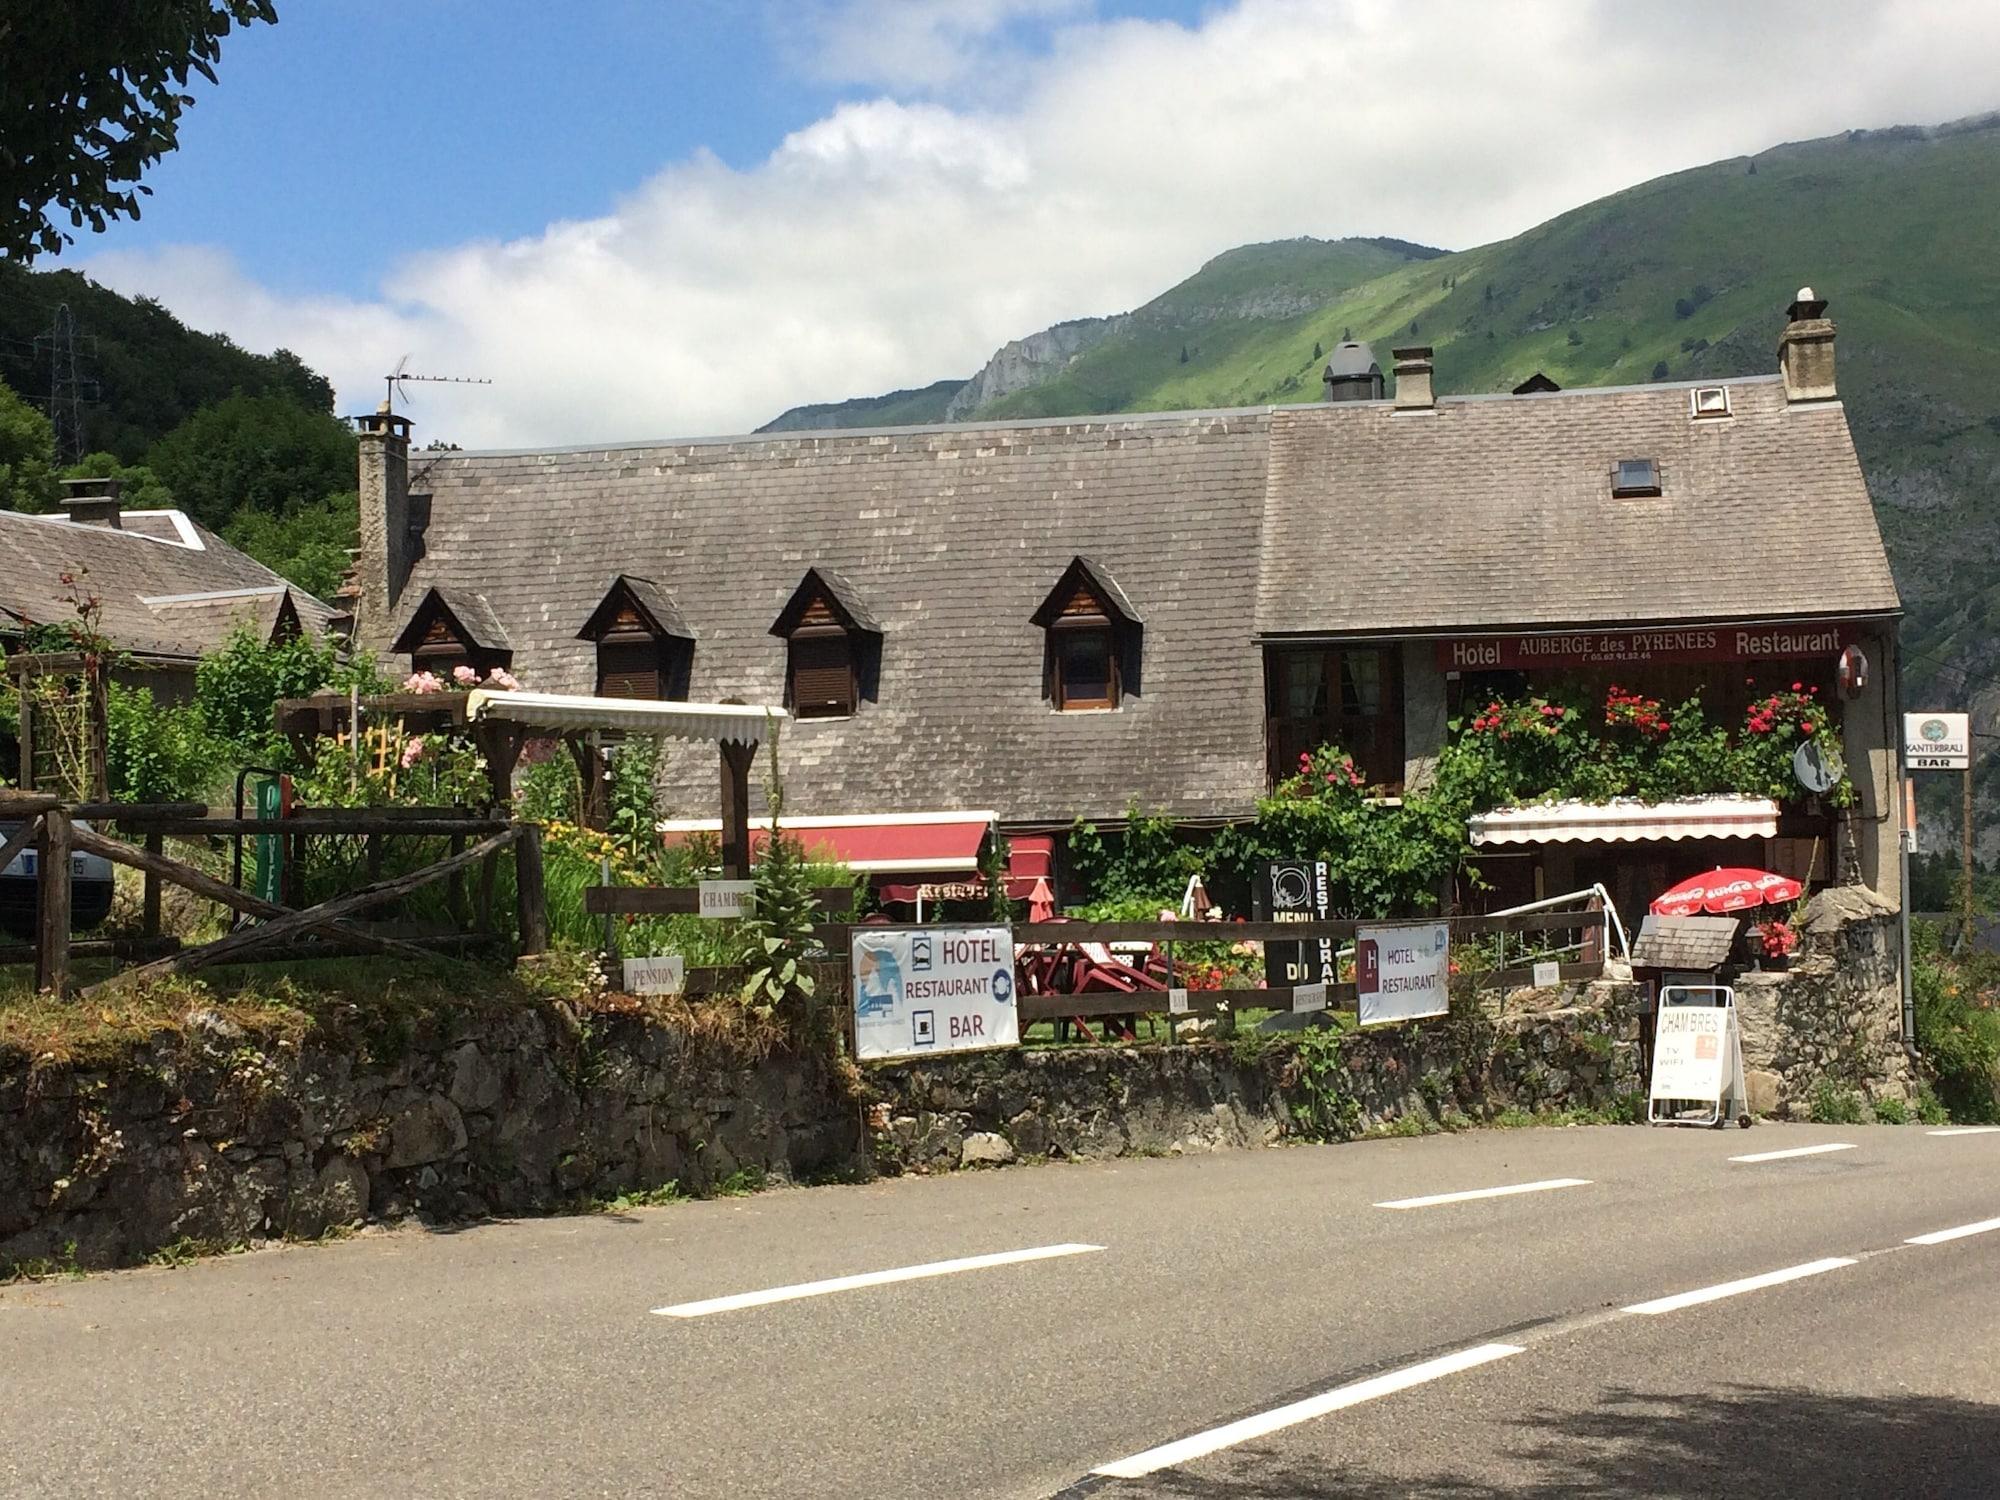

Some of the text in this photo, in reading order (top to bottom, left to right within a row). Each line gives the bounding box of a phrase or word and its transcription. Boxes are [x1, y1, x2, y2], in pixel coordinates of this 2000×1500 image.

[1453, 629, 1841, 665] Hotel AUBERGE des PYRENEES Restaurant
[1917, 759, 1951, 767] BAR
[703, 891, 753, 908] CHAMB
[943, 938, 1001, 965] HOTEL
[1387, 948, 1416, 965] HOTEL
[633, 967, 675, 986] PENSION
[1382, 974, 1436, 994] RESTAURANT
[905, 977, 989, 1000] RESTAURANT
[950, 1014, 985, 1039] BAR
[1661, 1012, 1719, 1034] CHAMBRES
